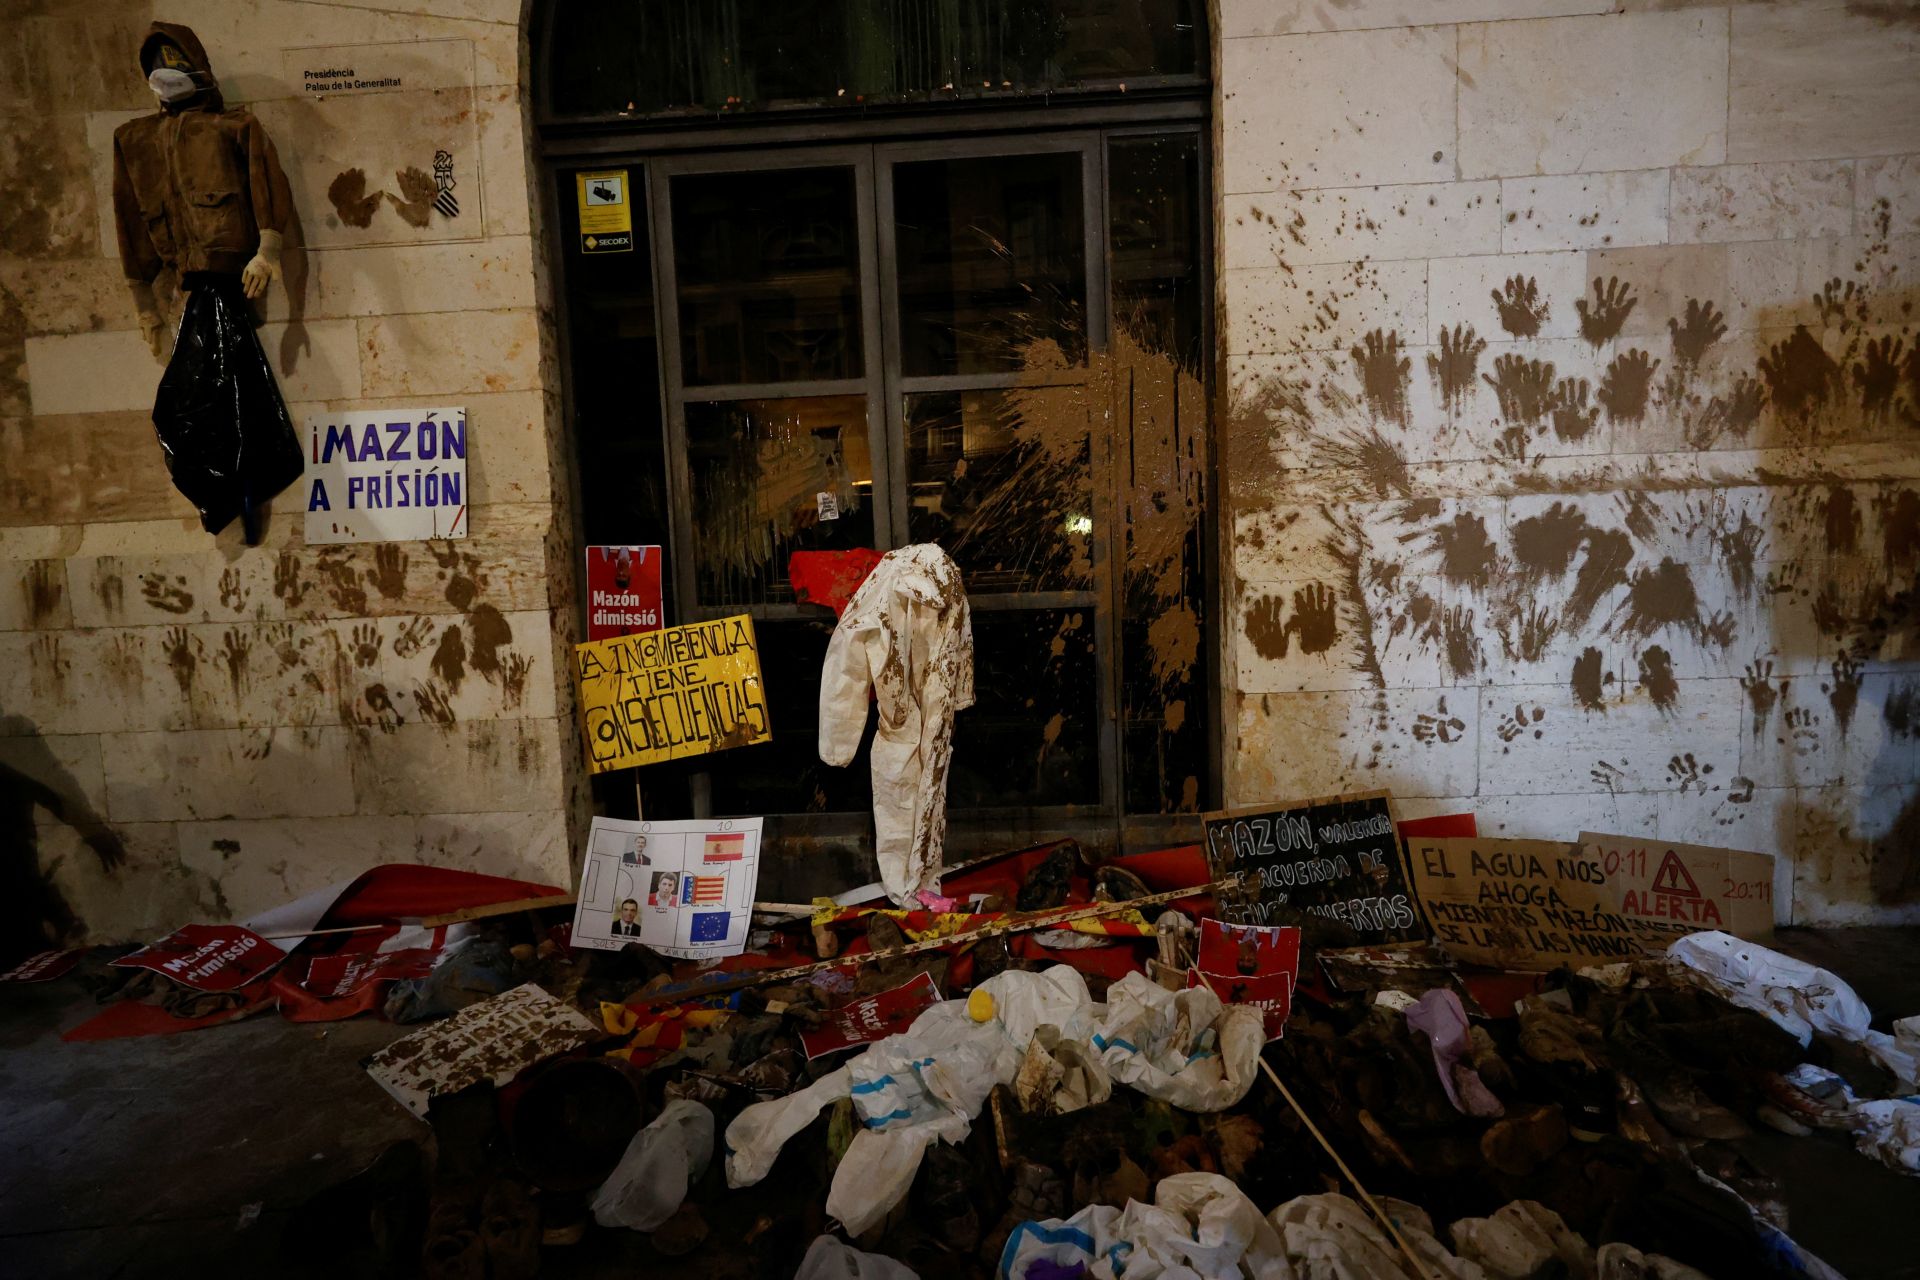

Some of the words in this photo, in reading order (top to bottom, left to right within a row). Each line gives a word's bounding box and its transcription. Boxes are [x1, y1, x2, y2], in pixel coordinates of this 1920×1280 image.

[304, 68, 354, 79] Presidència
[305, 82, 330, 91] Palau
[331, 81, 342, 90] de
[344, 80, 352, 89] la
[354, 77, 401, 89] Generalitat
[598, 237, 630, 246] SECOEX
[312, 412, 465, 464] ¡MAZÓN
[308, 479, 331, 511] A
[592, 590, 640, 607] Mazón
[592, 609, 657, 626] dimissió
[576, 649, 610, 682] LA
[608, 620, 755, 675] INCOMPETENCIA
[627, 663, 706, 697] TIENE
[585, 676, 767, 763] CONSECUENCIAS
[1209, 810, 1319, 862] MAZÓN,
[1258, 854, 1351, 889] ACUERDA
[1357, 848, 1387, 876] DE
[1422, 848, 1455, 878] EL
[1471, 850, 1548, 879] AGUA
[1556, 858, 1605, 884] NOS
[1478, 881, 1568, 908] AHOGA
[1722, 877, 1770, 904] 20:11
[1427, 900, 1538, 928] MIENTRAS
[1543, 903, 1630, 933] MAZÓN
[1622, 890, 1723, 925] ALERTA
[1437, 923, 1468, 945] SE
[1525, 928, 1571, 953] LAS
[1568, 933, 1644, 957] MANOS
